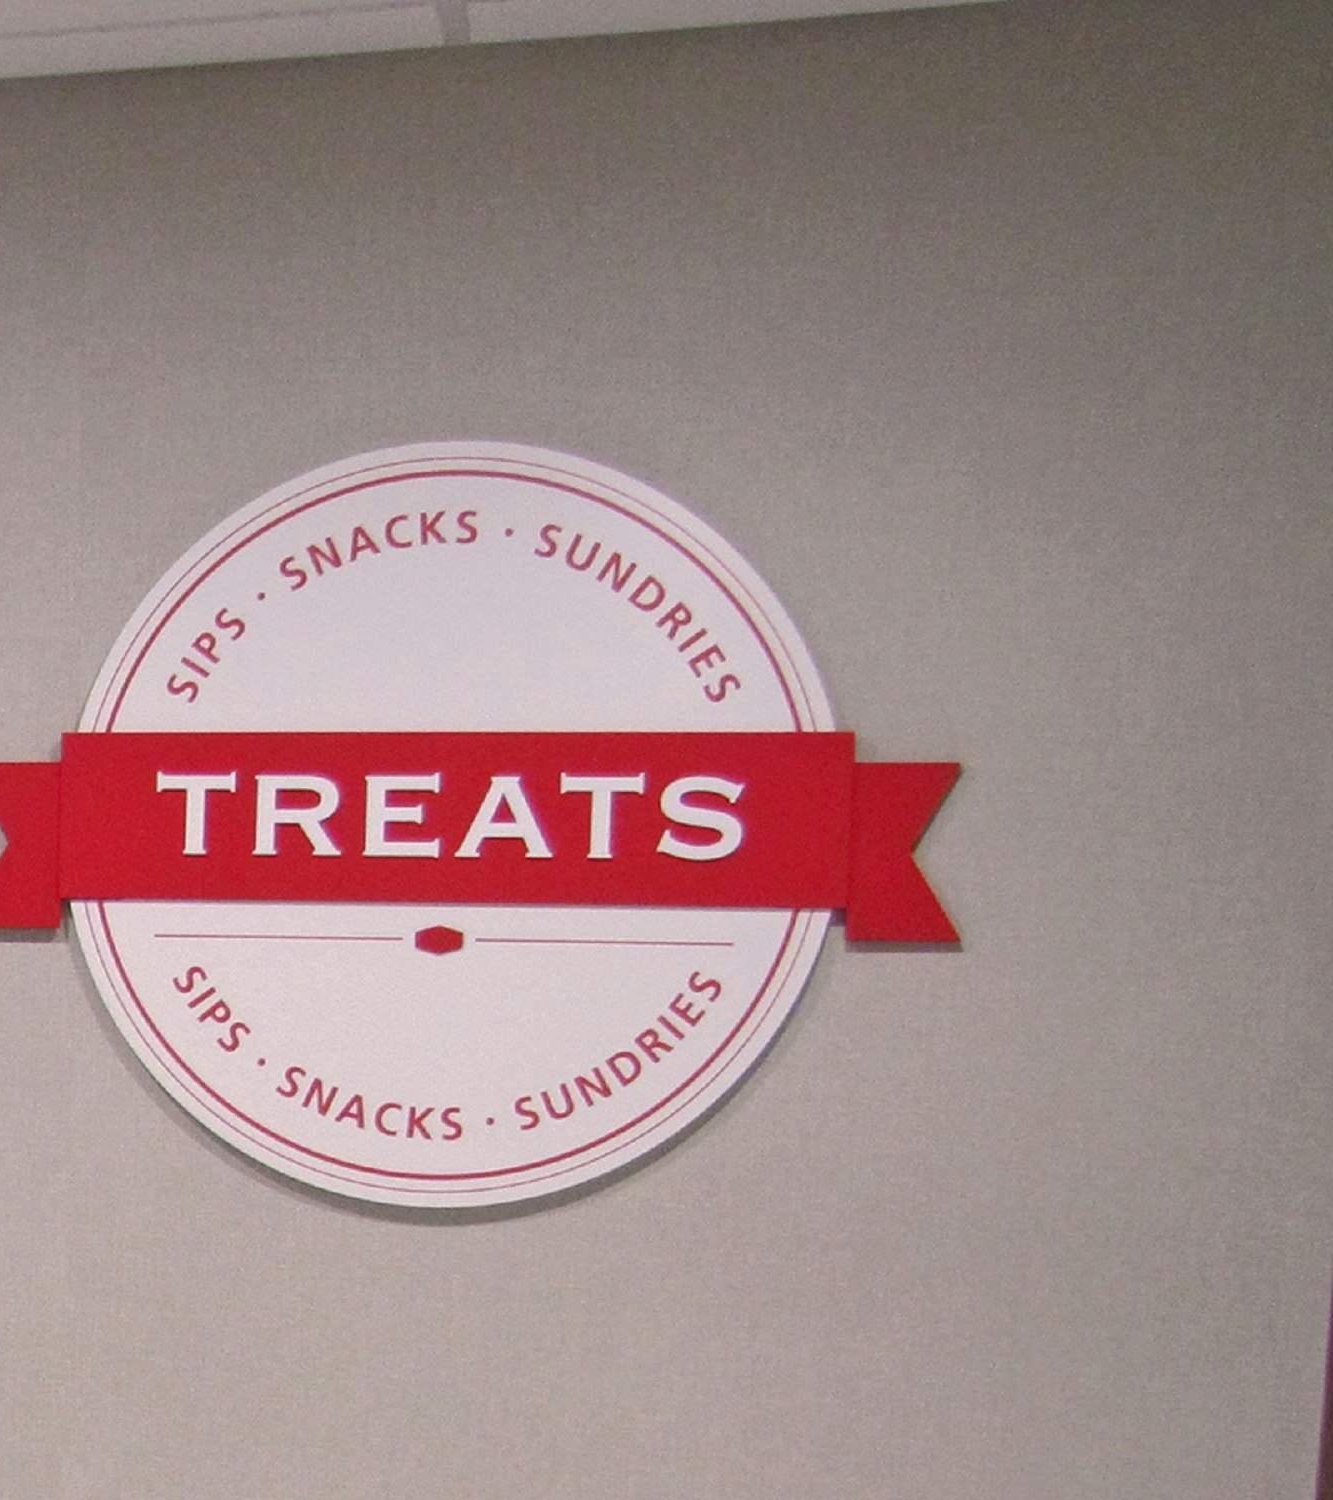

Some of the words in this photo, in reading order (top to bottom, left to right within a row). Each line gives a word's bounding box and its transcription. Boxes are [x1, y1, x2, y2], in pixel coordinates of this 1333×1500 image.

[167, 606, 246, 704] SIPS
[278, 508, 481, 592] SNACKS
[533, 521, 741, 704] SUNDRIES
[156, 770, 746, 861] TREATS
[173, 965, 250, 1055] SIPS
[276, 1064, 463, 1141] SNACKS
[514, 970, 723, 1131] SUNDRIES
